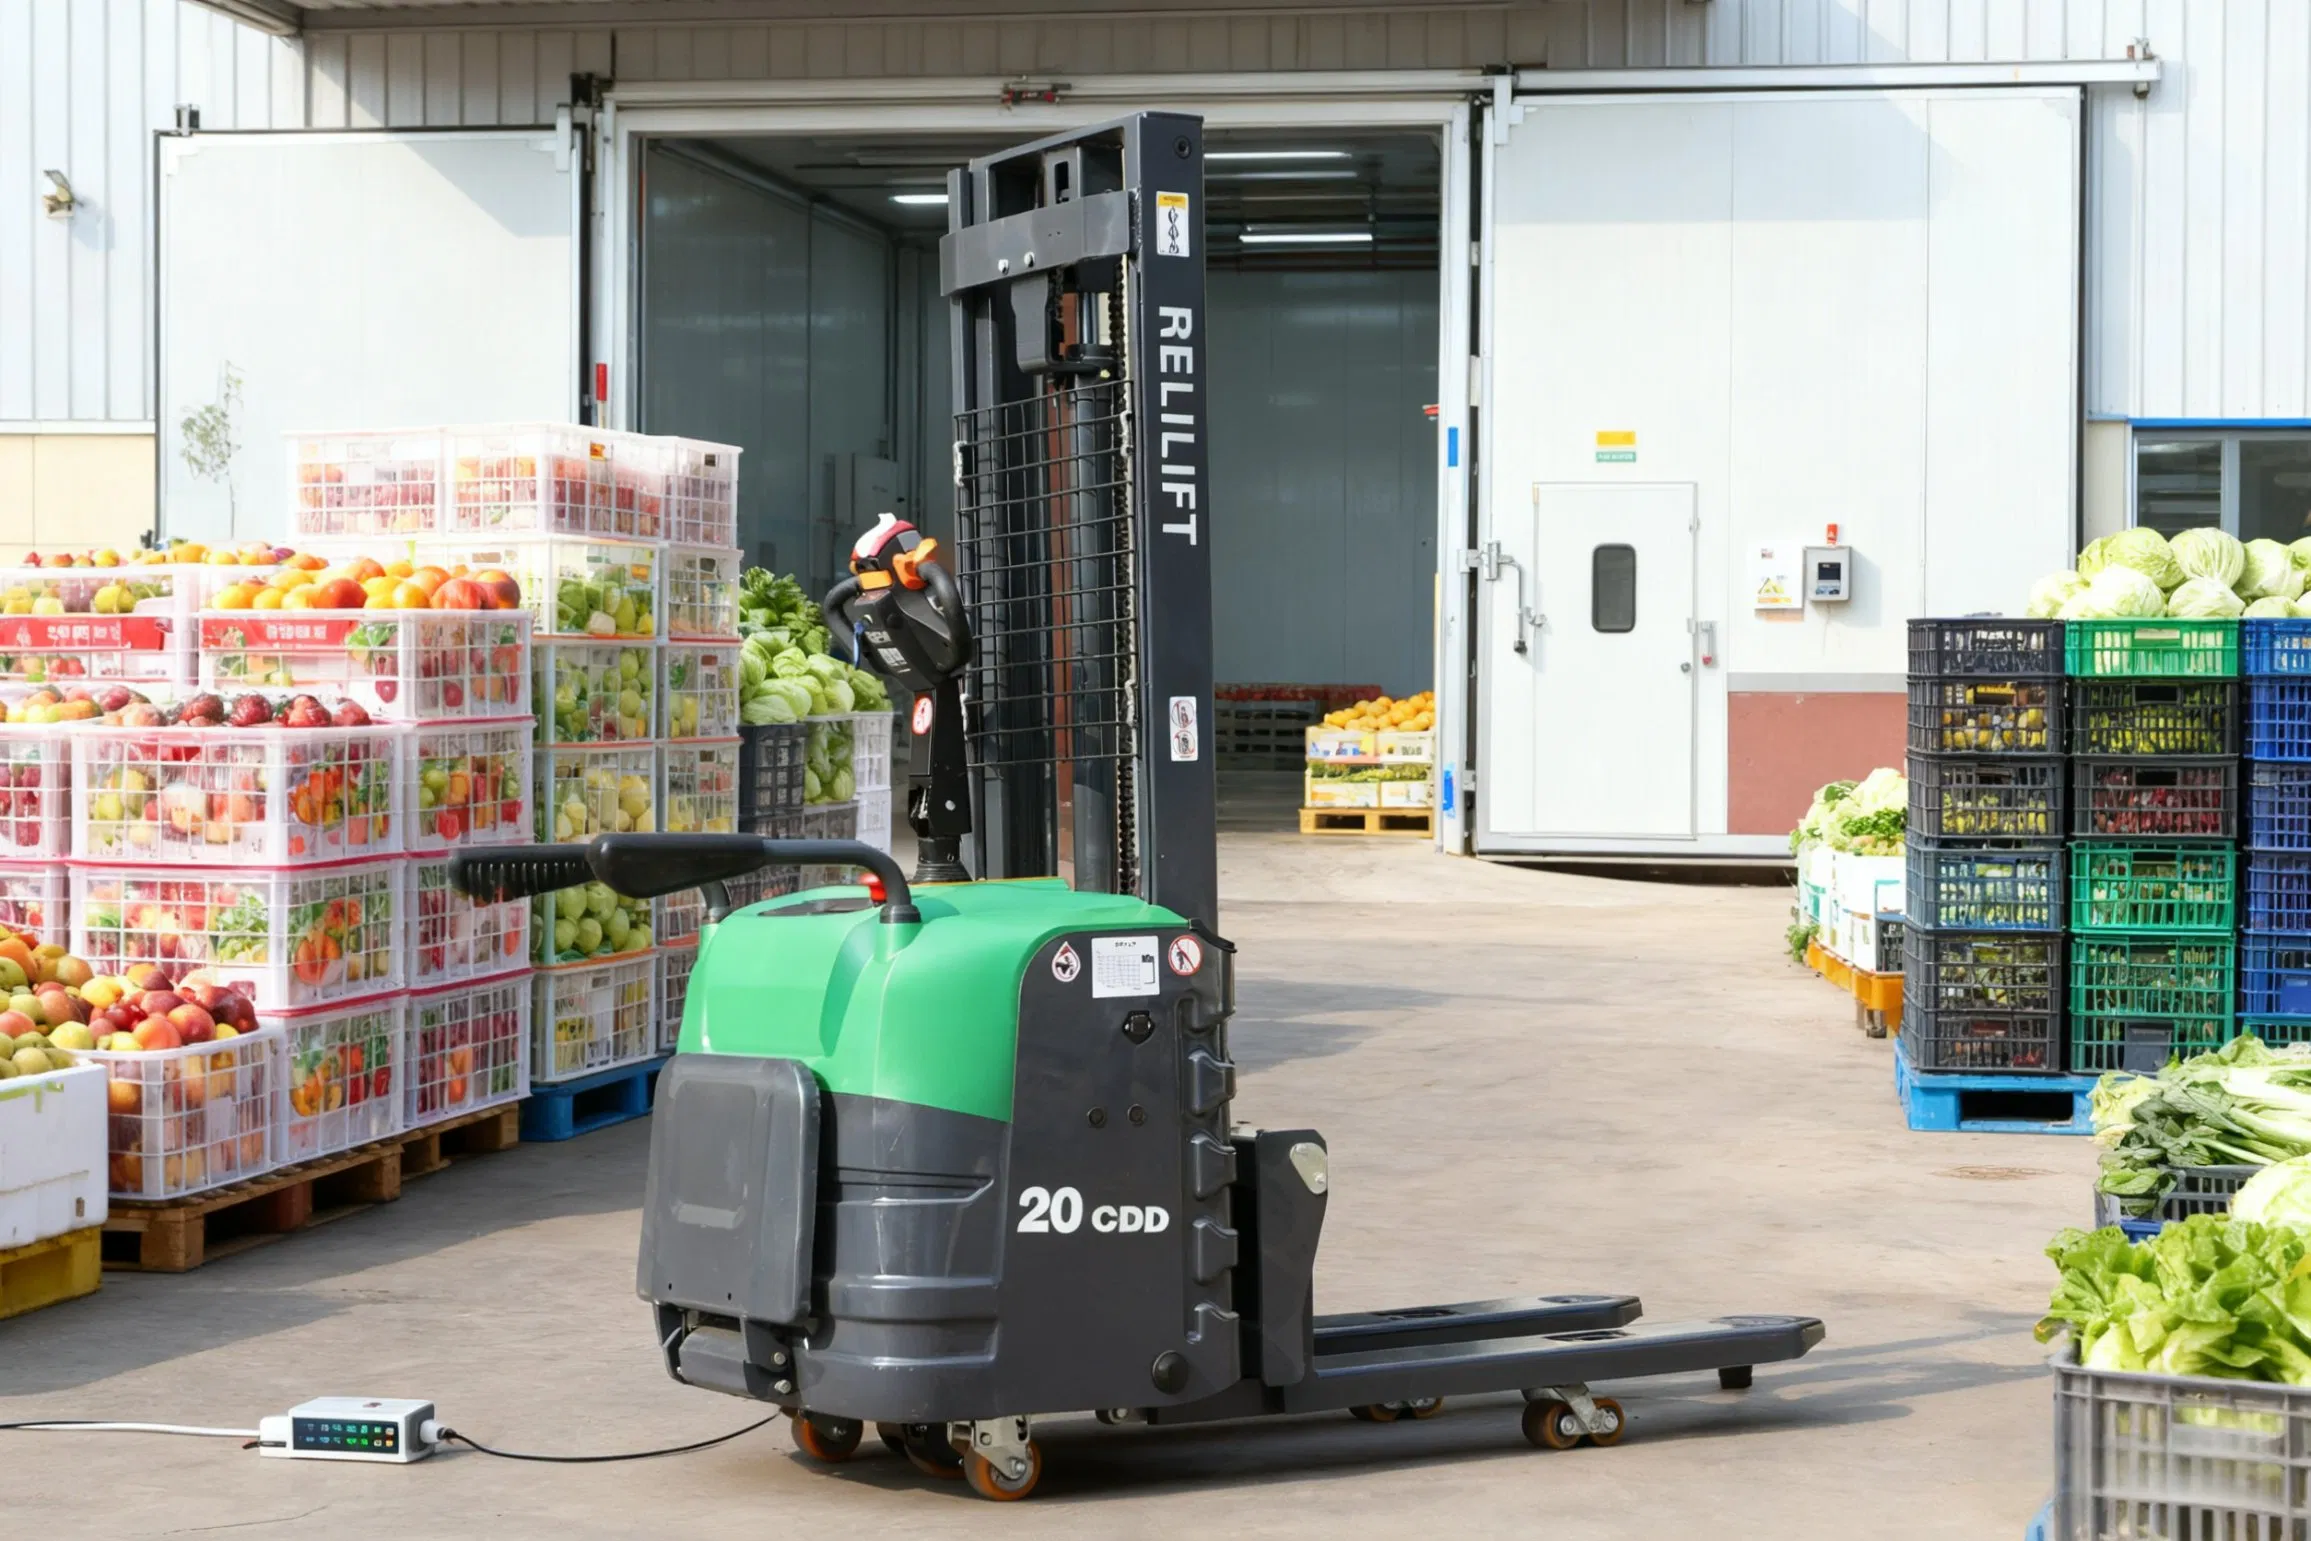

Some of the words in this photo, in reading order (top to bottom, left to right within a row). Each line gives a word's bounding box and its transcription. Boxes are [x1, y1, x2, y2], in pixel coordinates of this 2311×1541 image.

[1159, 306, 1197, 546] RELILIFT
[1017, 1186, 1083, 1234] 20
[1091, 1205, 1170, 1233] CDD
